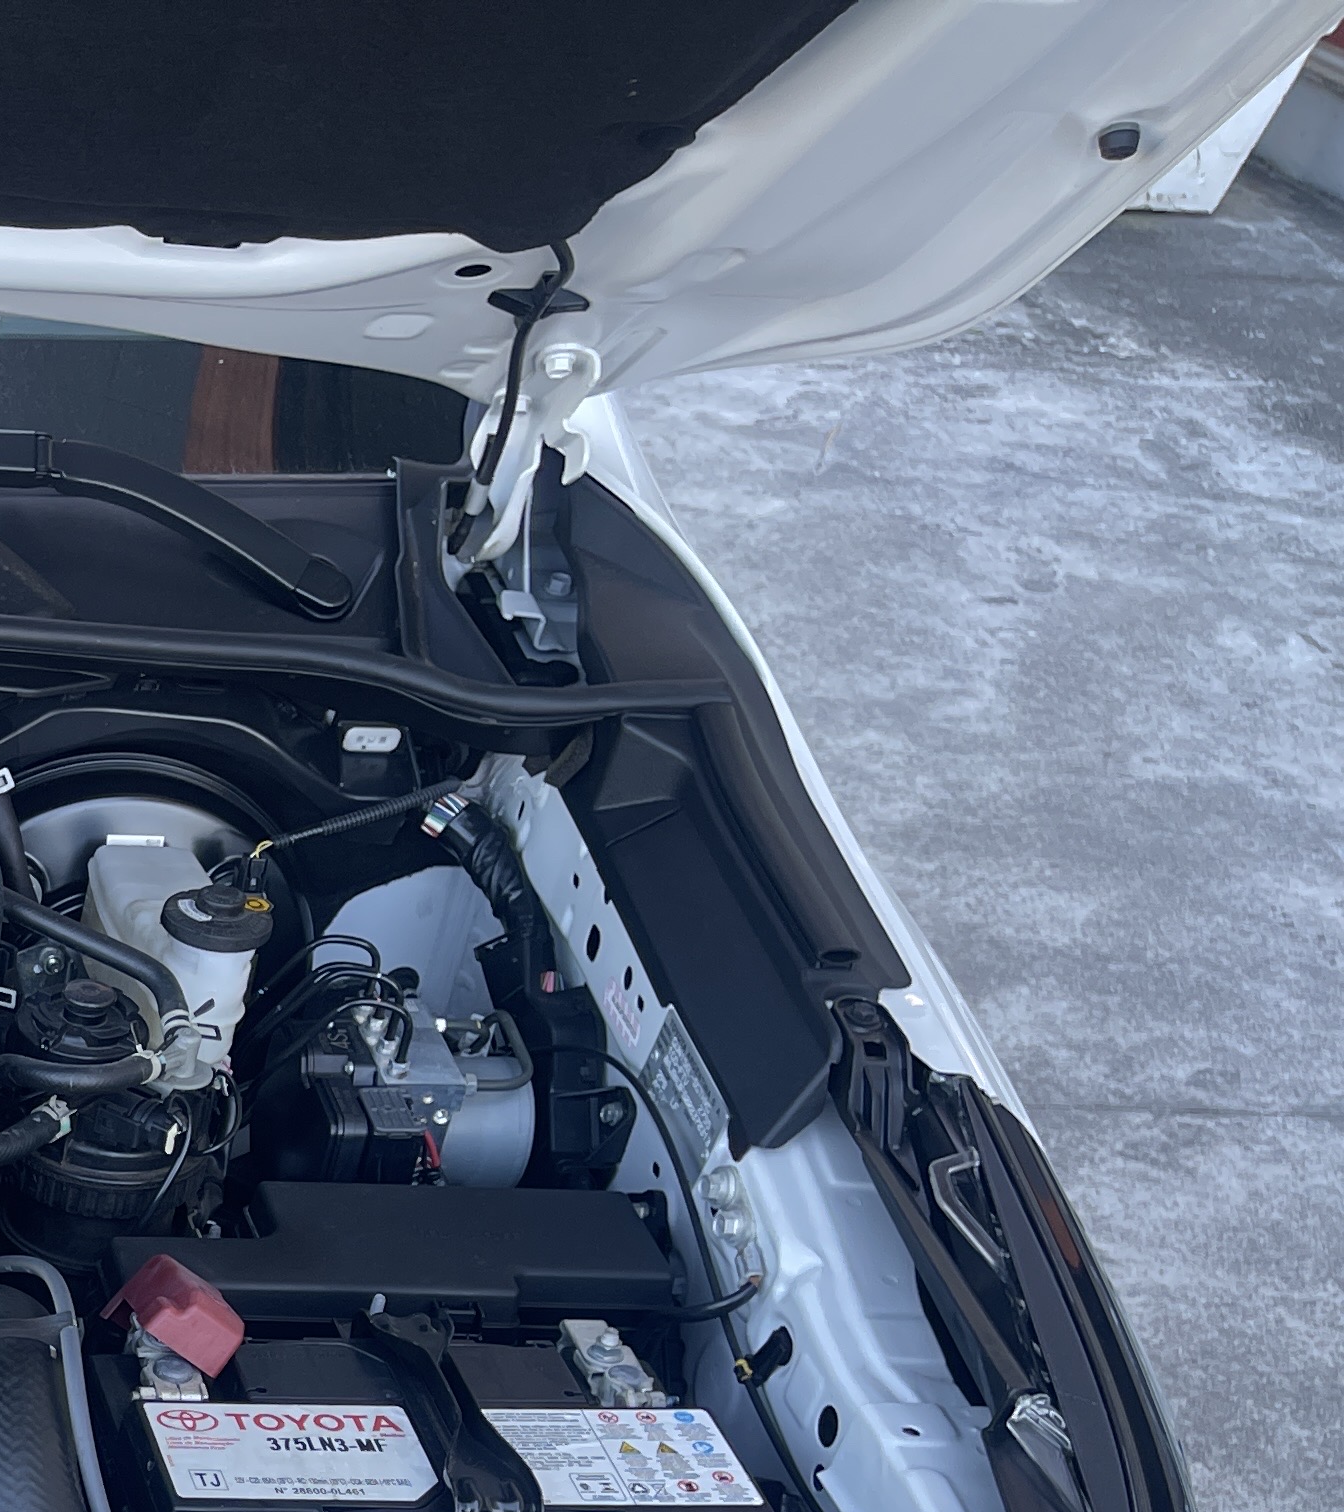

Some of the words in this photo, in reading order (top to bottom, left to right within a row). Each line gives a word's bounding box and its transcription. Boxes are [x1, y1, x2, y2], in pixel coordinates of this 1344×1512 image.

[224, 1413, 405, 1433] TOYOTA
[266, 1436, 389, 1453] 375LN3-MF
[194, 1472, 222, 1488] TJ
